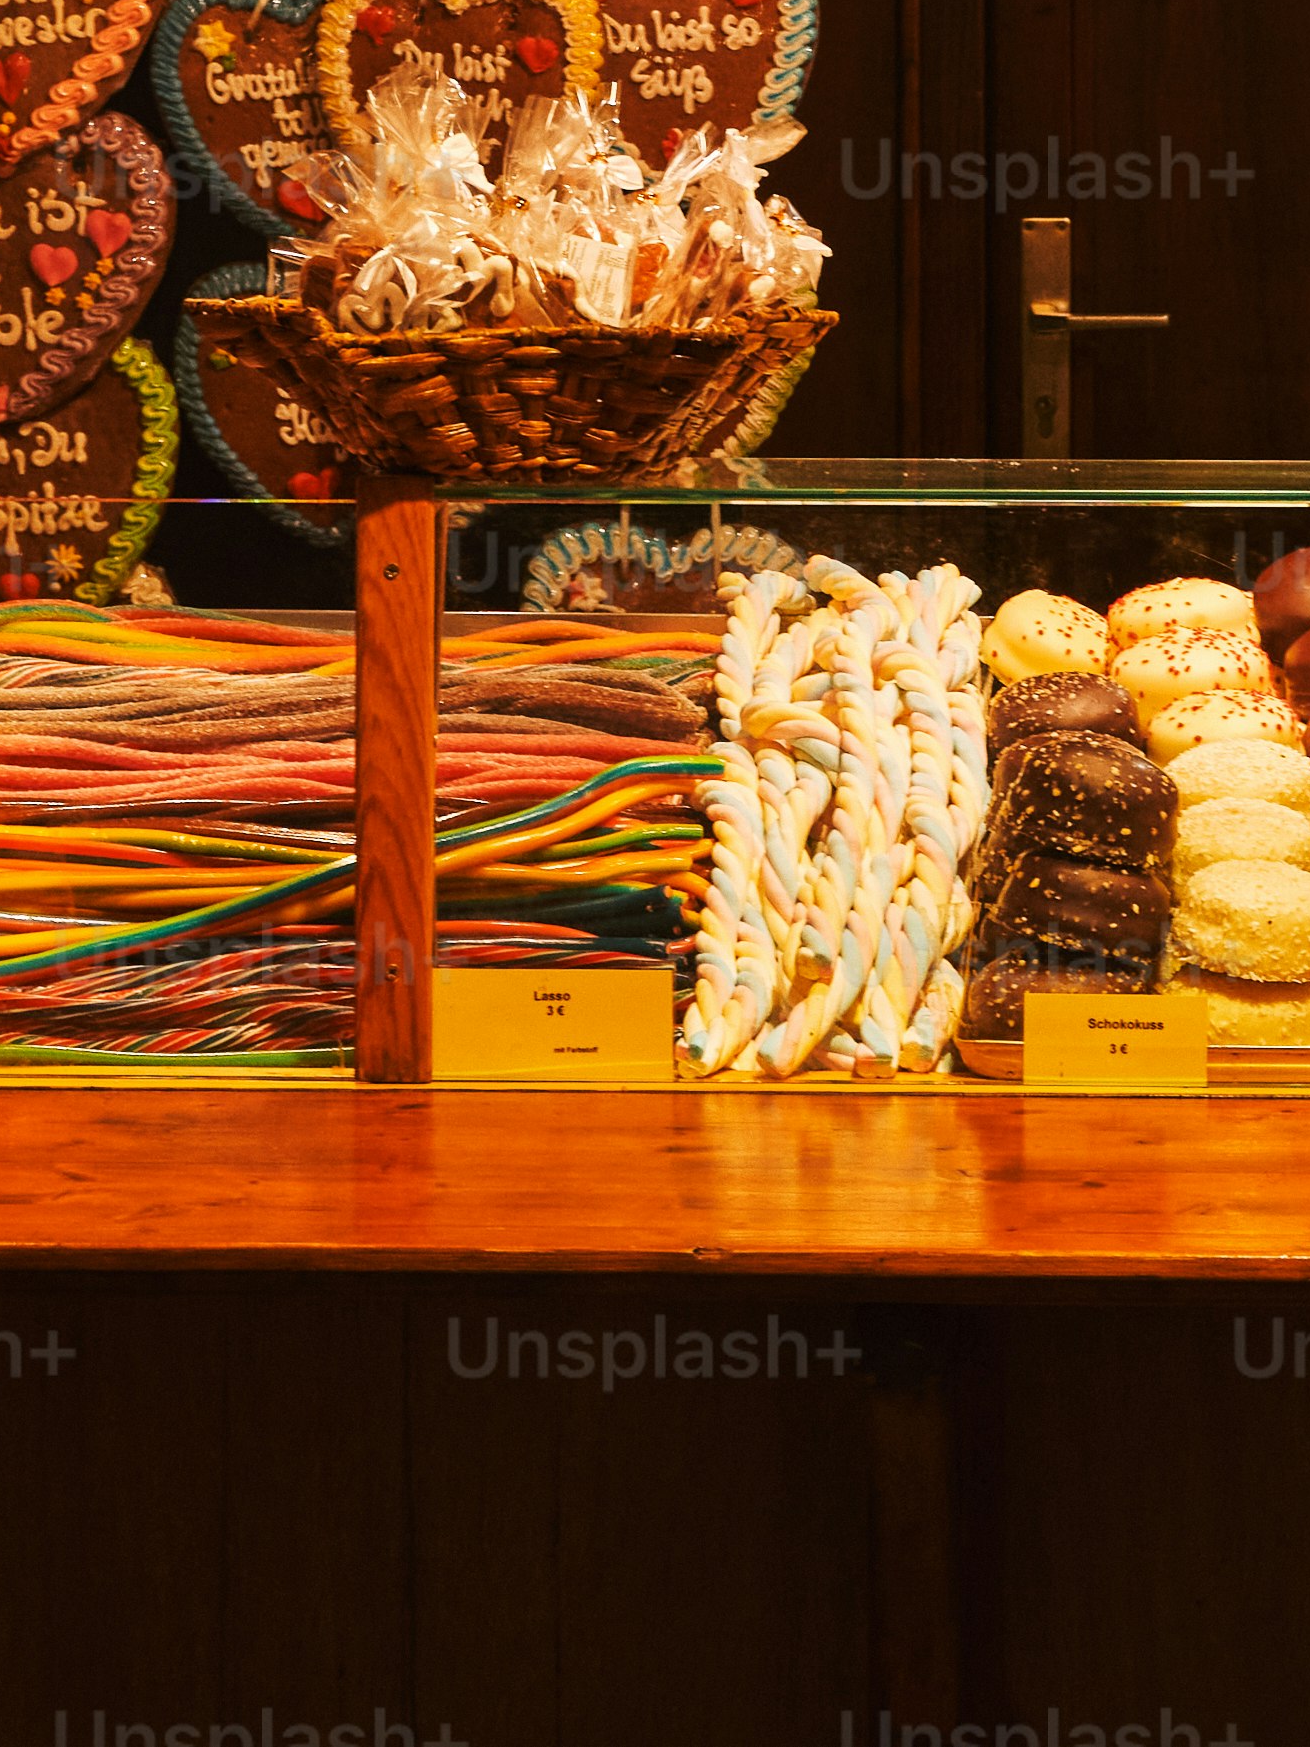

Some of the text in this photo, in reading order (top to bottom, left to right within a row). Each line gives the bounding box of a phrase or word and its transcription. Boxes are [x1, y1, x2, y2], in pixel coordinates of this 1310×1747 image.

[602, 12, 652, 54] Du
[25, 180, 108, 237] ist
[533, 990, 571, 1003] Lasso
[547, 1005, 565, 1016] 3 €
[1087, 1017, 1164, 1031] Schokokuss
[1109, 1043, 1128, 1055] 3 €
